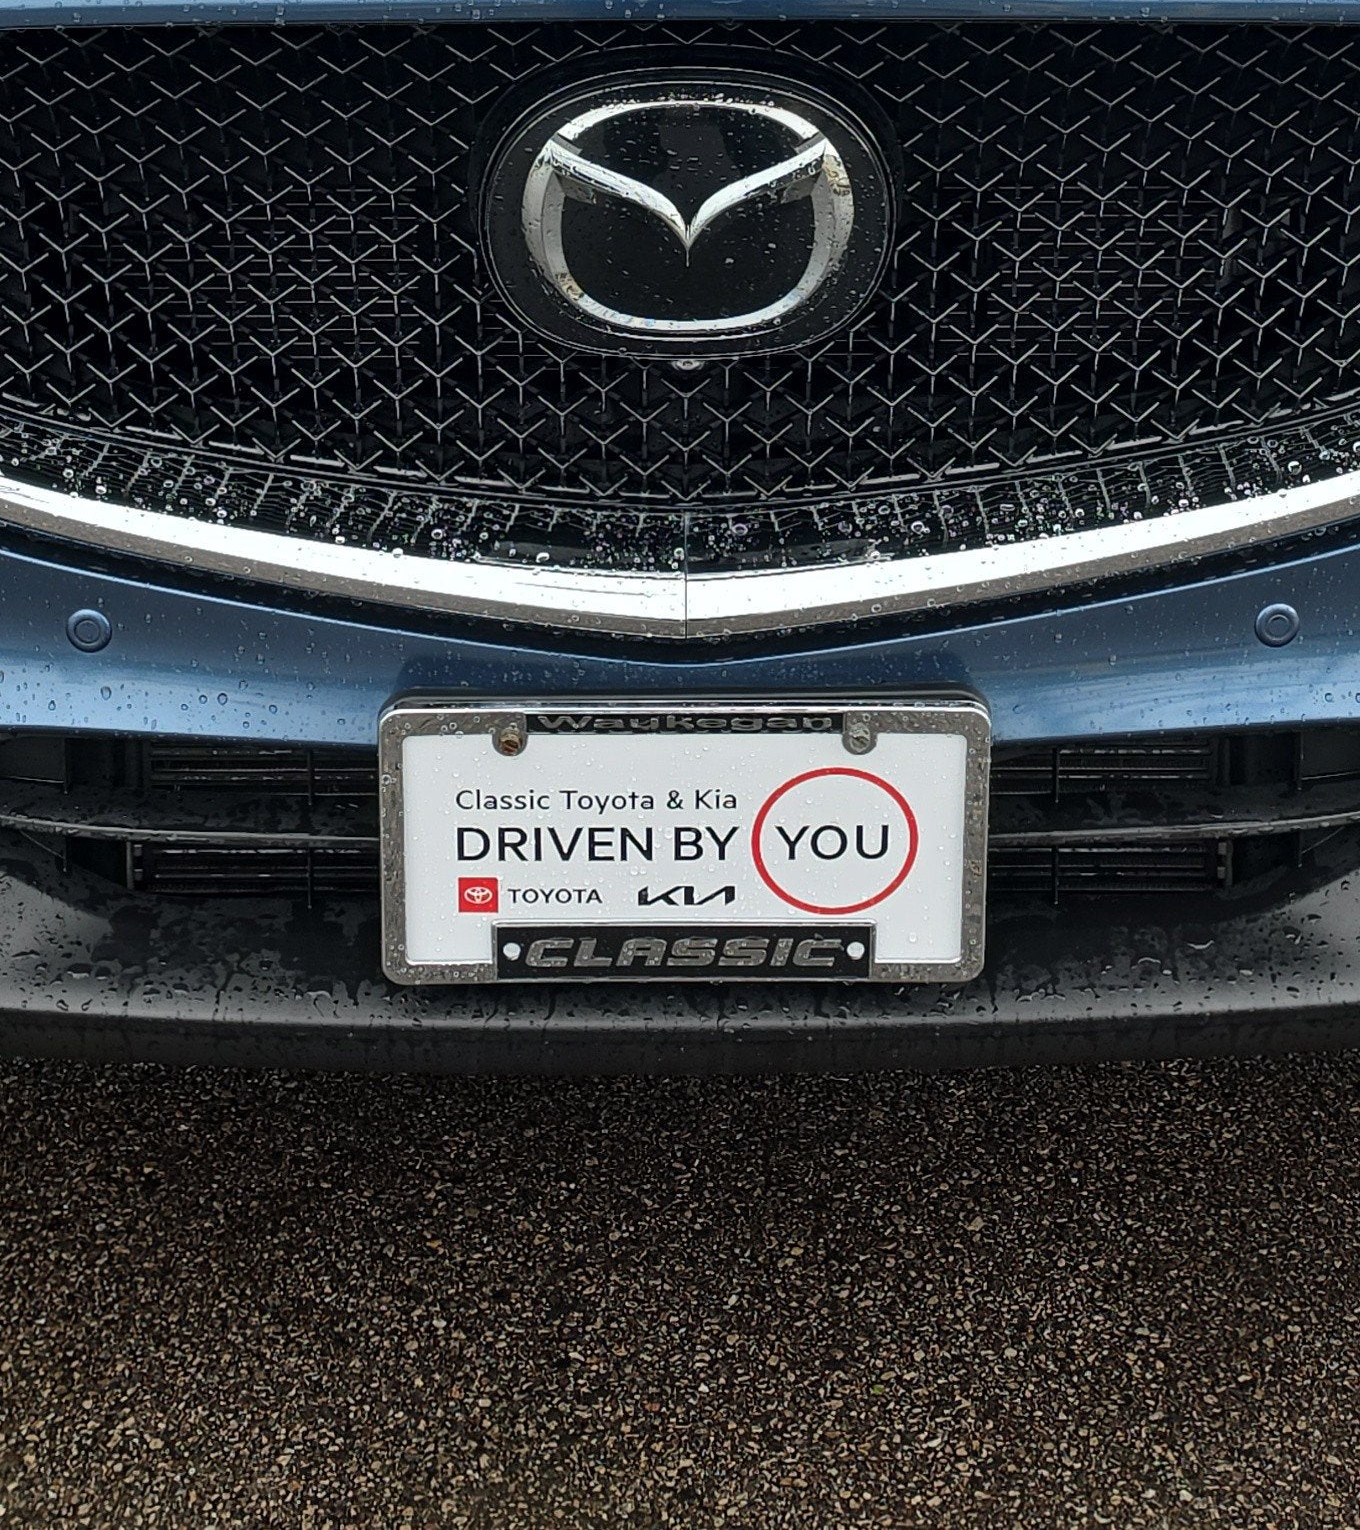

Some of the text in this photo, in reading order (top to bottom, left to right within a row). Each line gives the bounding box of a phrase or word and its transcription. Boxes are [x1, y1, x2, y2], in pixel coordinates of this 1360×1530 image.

[538, 715, 833, 731] Waukegan
[456, 789, 738, 815] Classic Toyota & Kia
[457, 824, 891, 862] DRIVEN BY YOU
[508, 887, 603, 905] TOYOTA
[525, 938, 846, 968] CLASSIC
